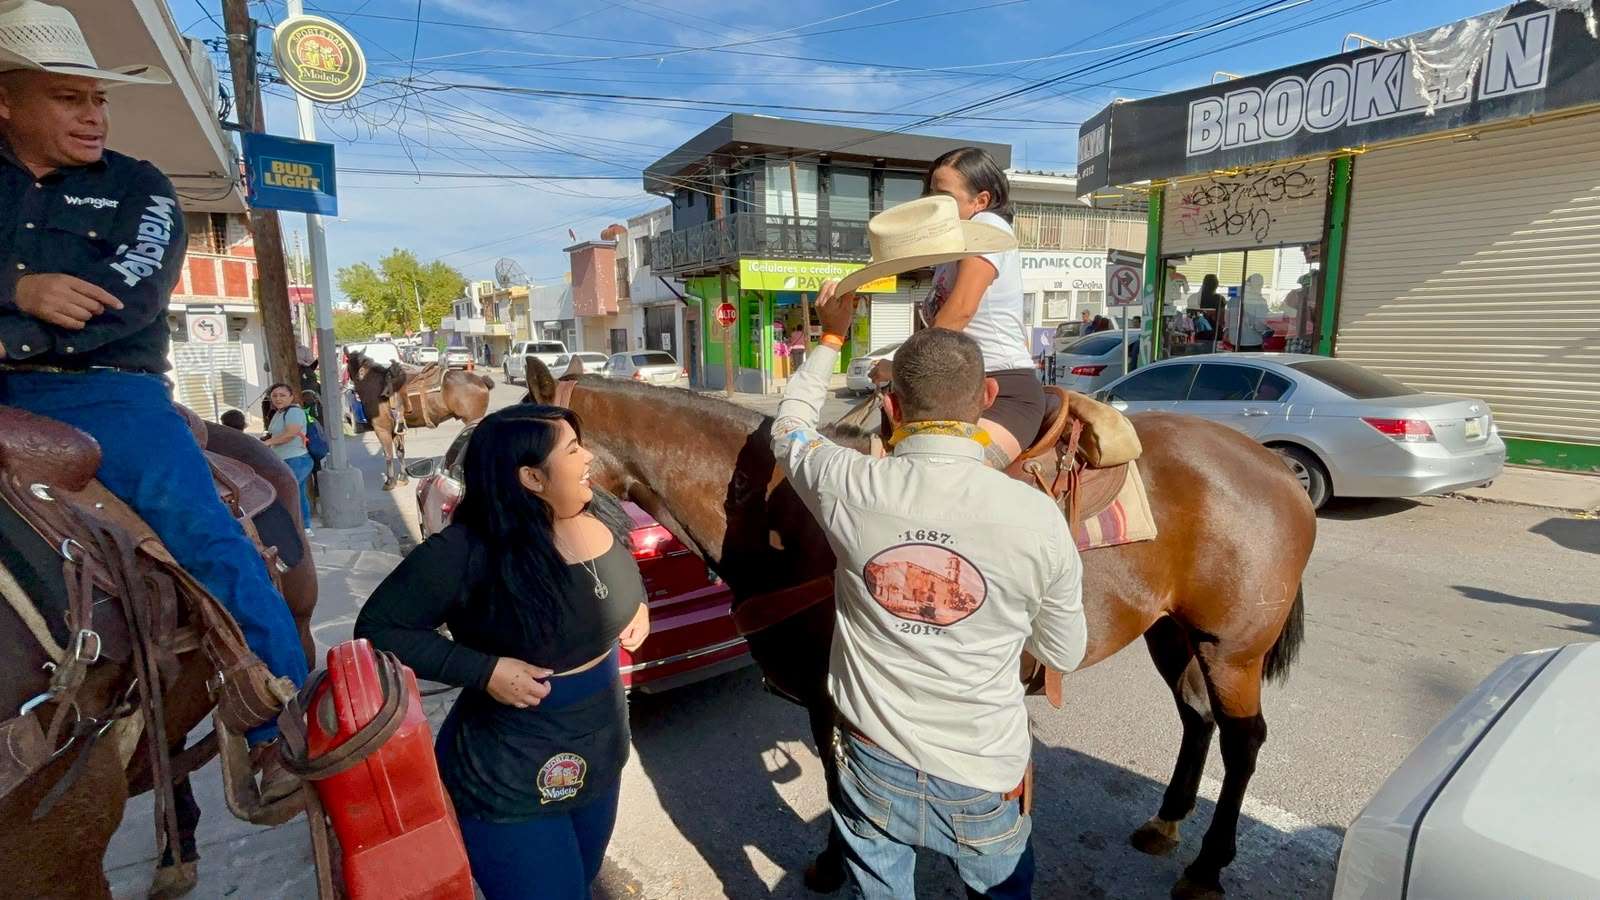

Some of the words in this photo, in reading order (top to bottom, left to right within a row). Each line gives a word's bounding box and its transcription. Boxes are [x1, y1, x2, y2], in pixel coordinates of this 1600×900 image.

[293, 28, 326, 43] SPORTS
[328, 33, 345, 50] BAR
[303, 67, 341, 83] Modelo
[1187, 9, 1556, 158] BROOKLN
[271, 160, 312, 177] BUD
[264, 172, 320, 191] LIGHT
[63, 194, 119, 209] Wrangler
[109, 195, 176, 287] Wrangler
[1073, 256, 1107, 269] COR
[718, 309, 736, 319] ALTO
[543, 787, 576, 798] Modelo
